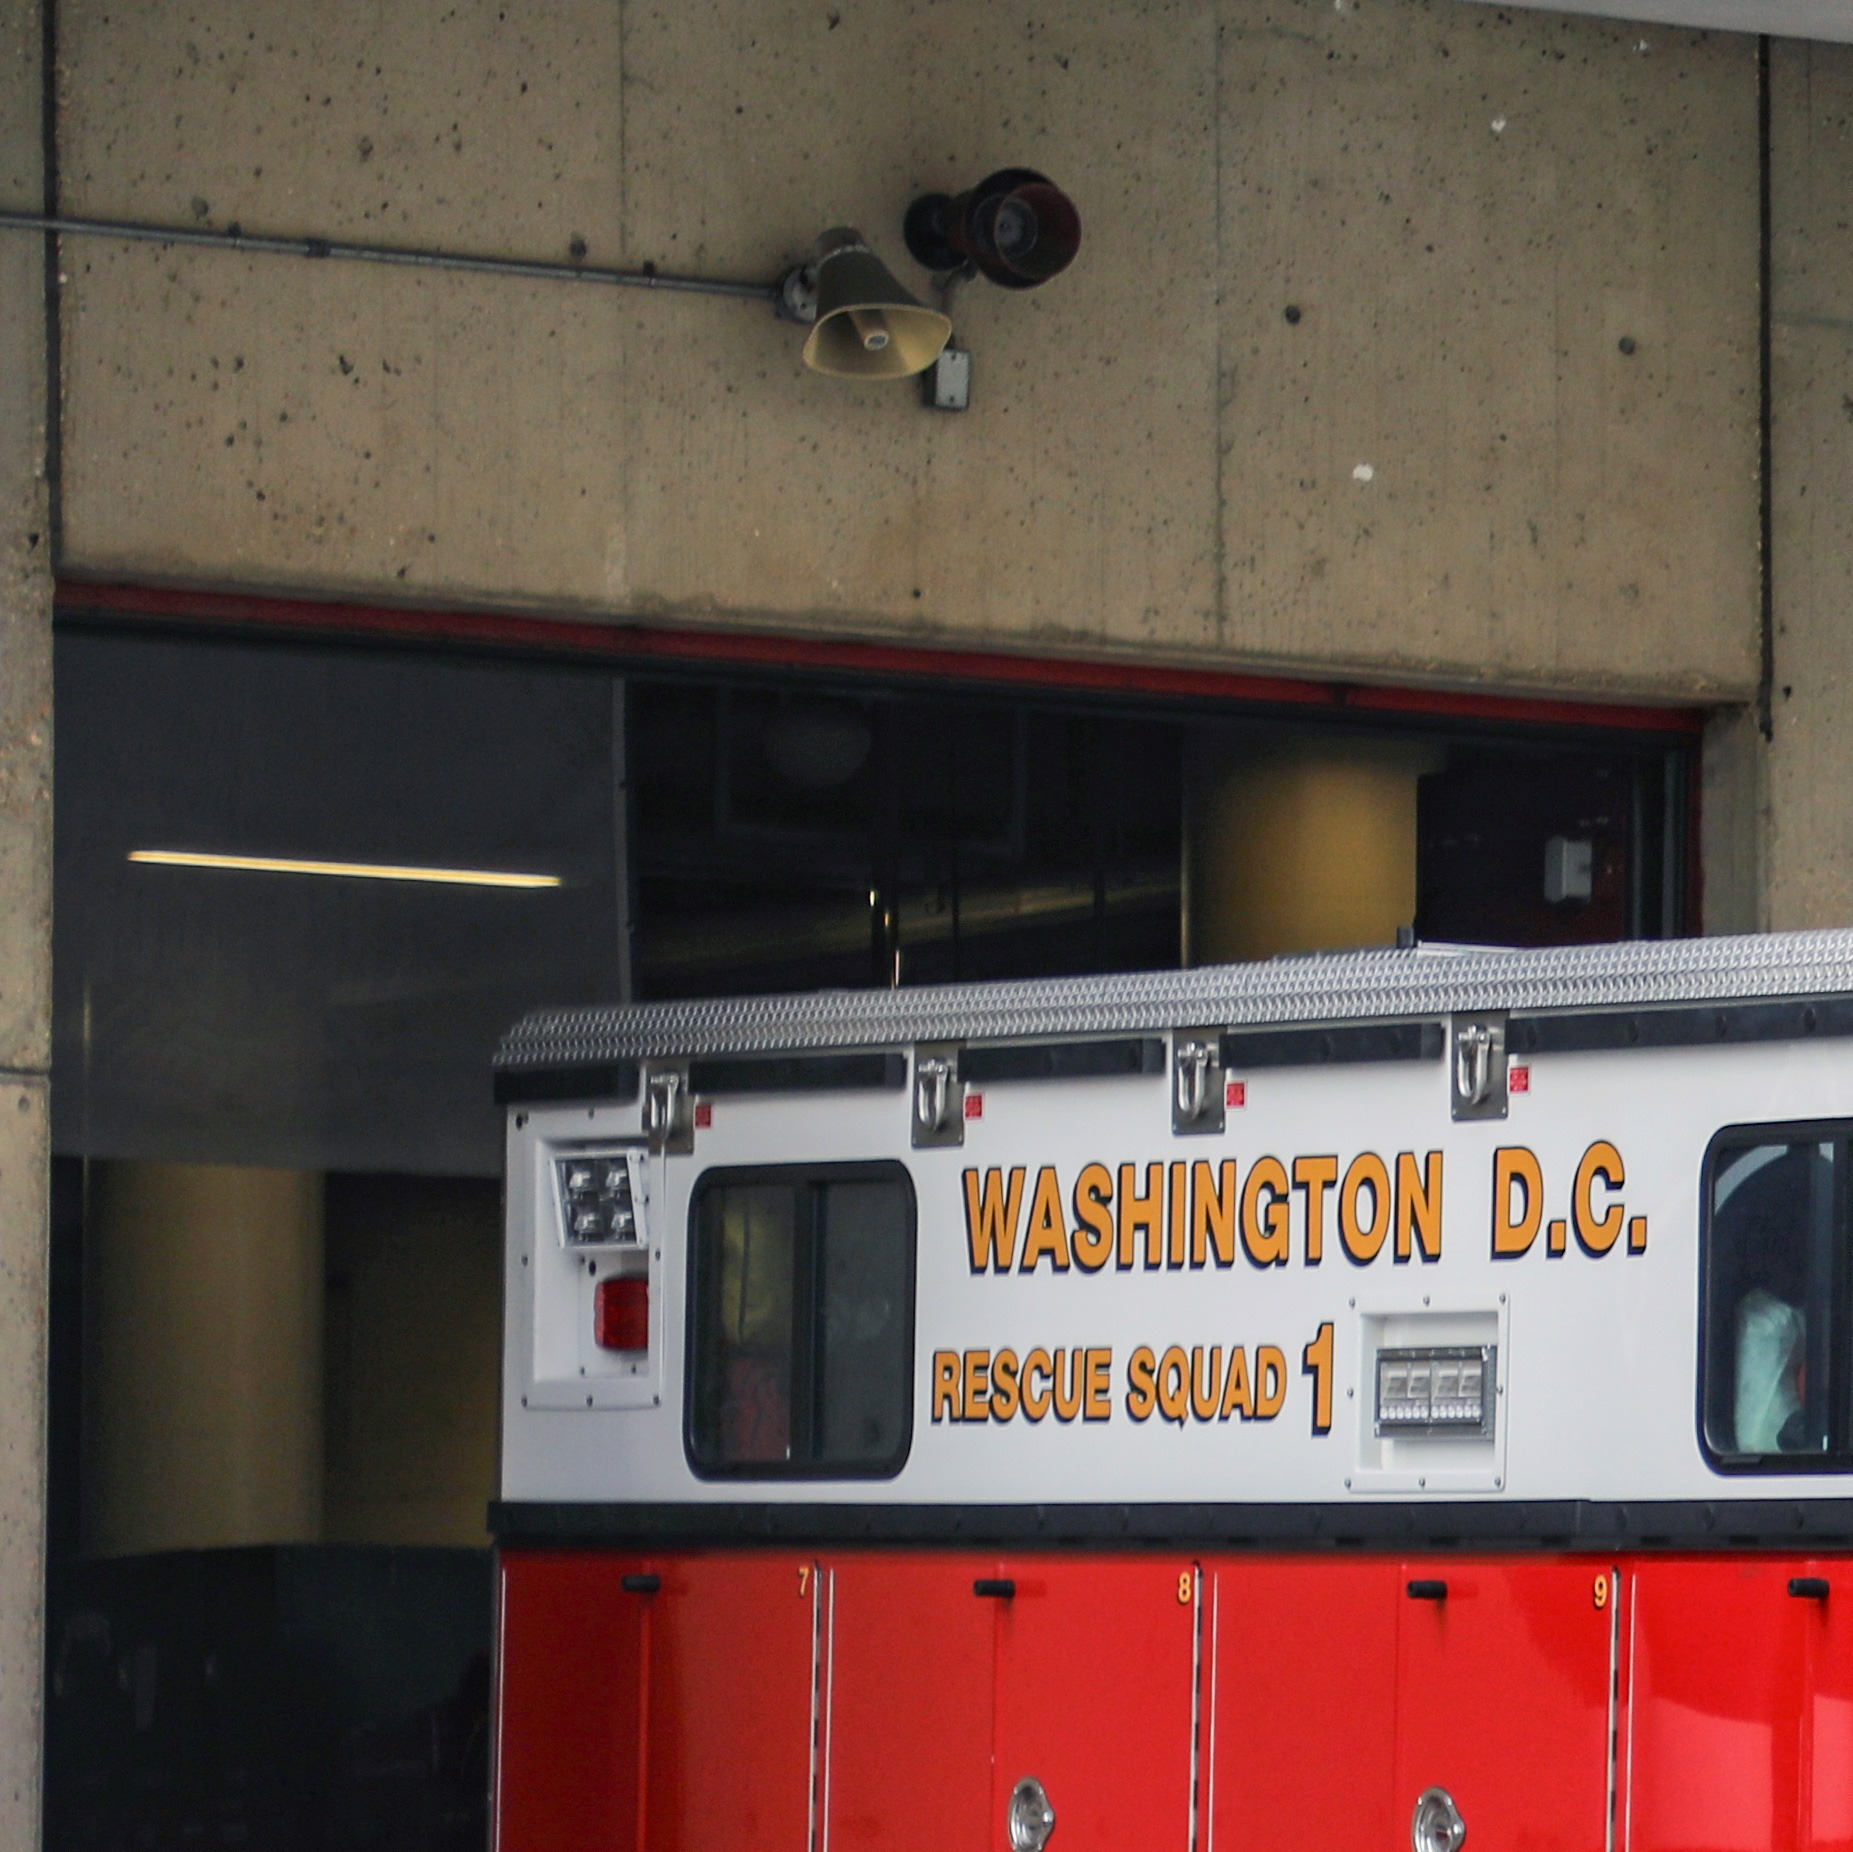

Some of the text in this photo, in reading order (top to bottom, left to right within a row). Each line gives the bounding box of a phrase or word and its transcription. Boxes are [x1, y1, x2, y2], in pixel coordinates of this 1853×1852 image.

[963, 1141, 1648, 1275] WASHINGTON D.C.
[931, 1323, 1336, 1437] RESCUE SQUAD 1
[800, 1566, 811, 1597] 7
[1178, 1572, 1193, 1604] 8
[1593, 1575, 1609, 1609] 9
